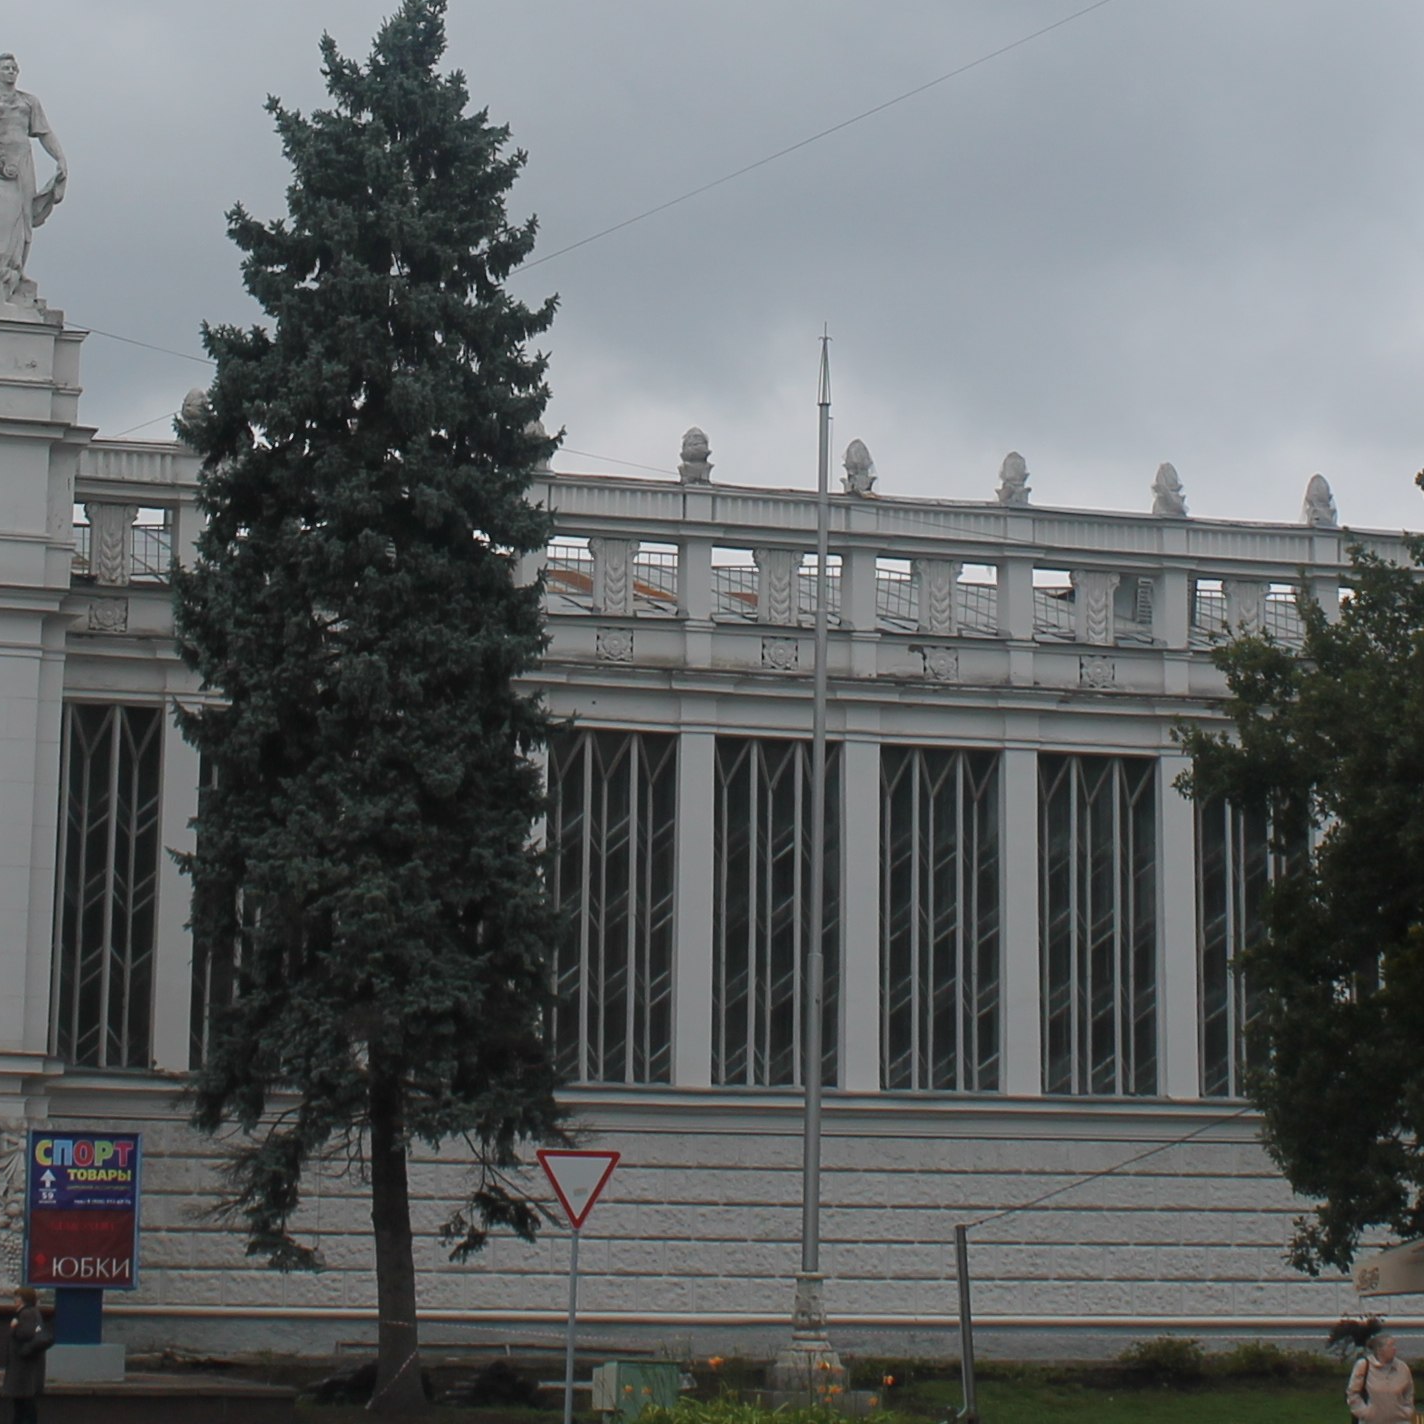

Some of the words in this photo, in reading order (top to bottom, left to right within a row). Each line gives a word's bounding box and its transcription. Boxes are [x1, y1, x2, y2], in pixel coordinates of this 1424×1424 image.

[35, 1139, 134, 1167] СПОРТ
[66, 1169, 132, 1182] ТОВАРЫ
[52, 1257, 130, 1278] ЮБКИ
